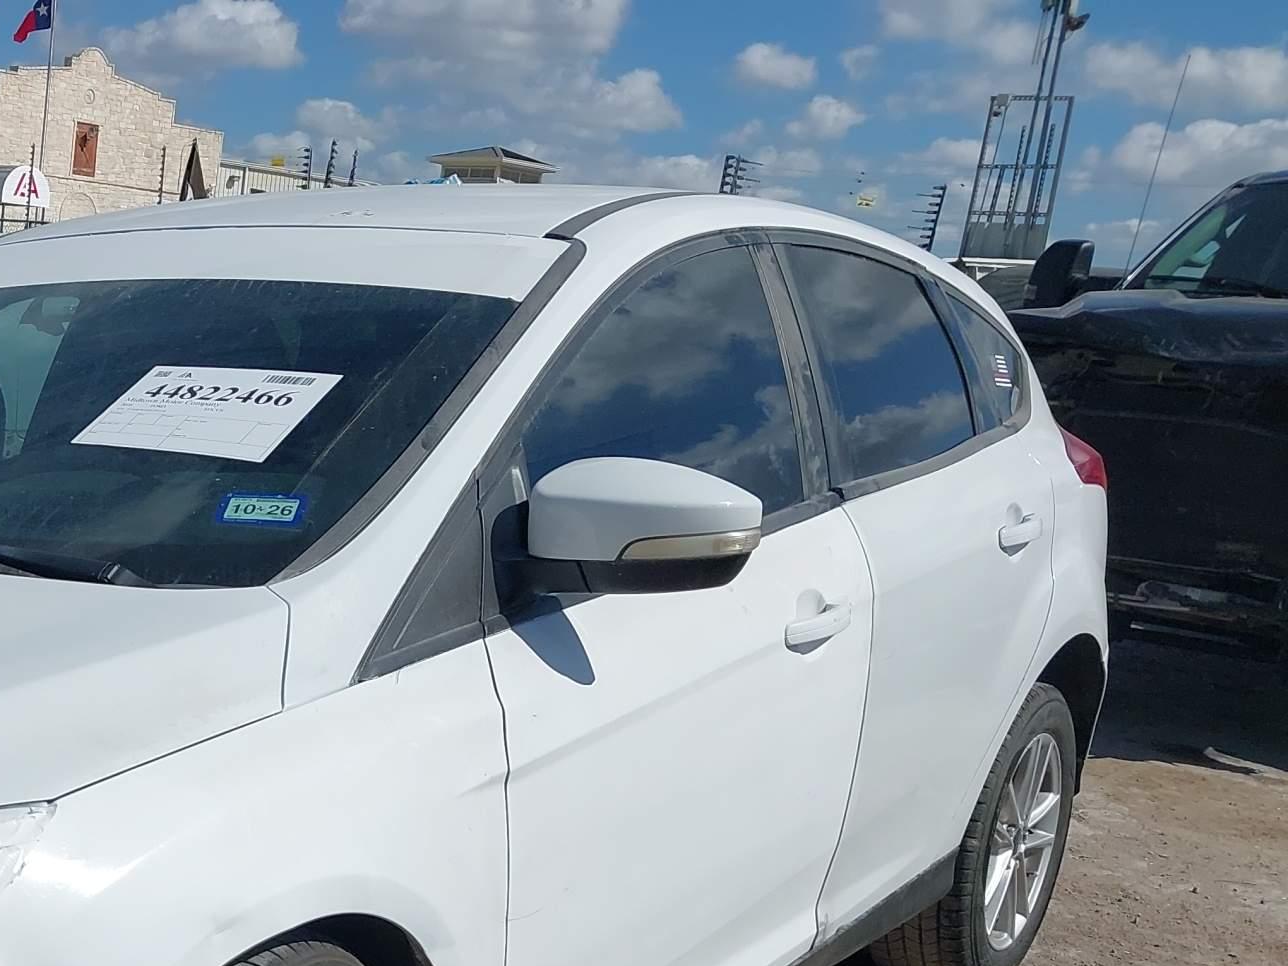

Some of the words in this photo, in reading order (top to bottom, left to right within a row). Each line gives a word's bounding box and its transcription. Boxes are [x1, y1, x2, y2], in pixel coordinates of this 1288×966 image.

[144, 383, 300, 407] 44822466
[232, 503, 257, 515] 10
[265, 504, 294, 517] 26
